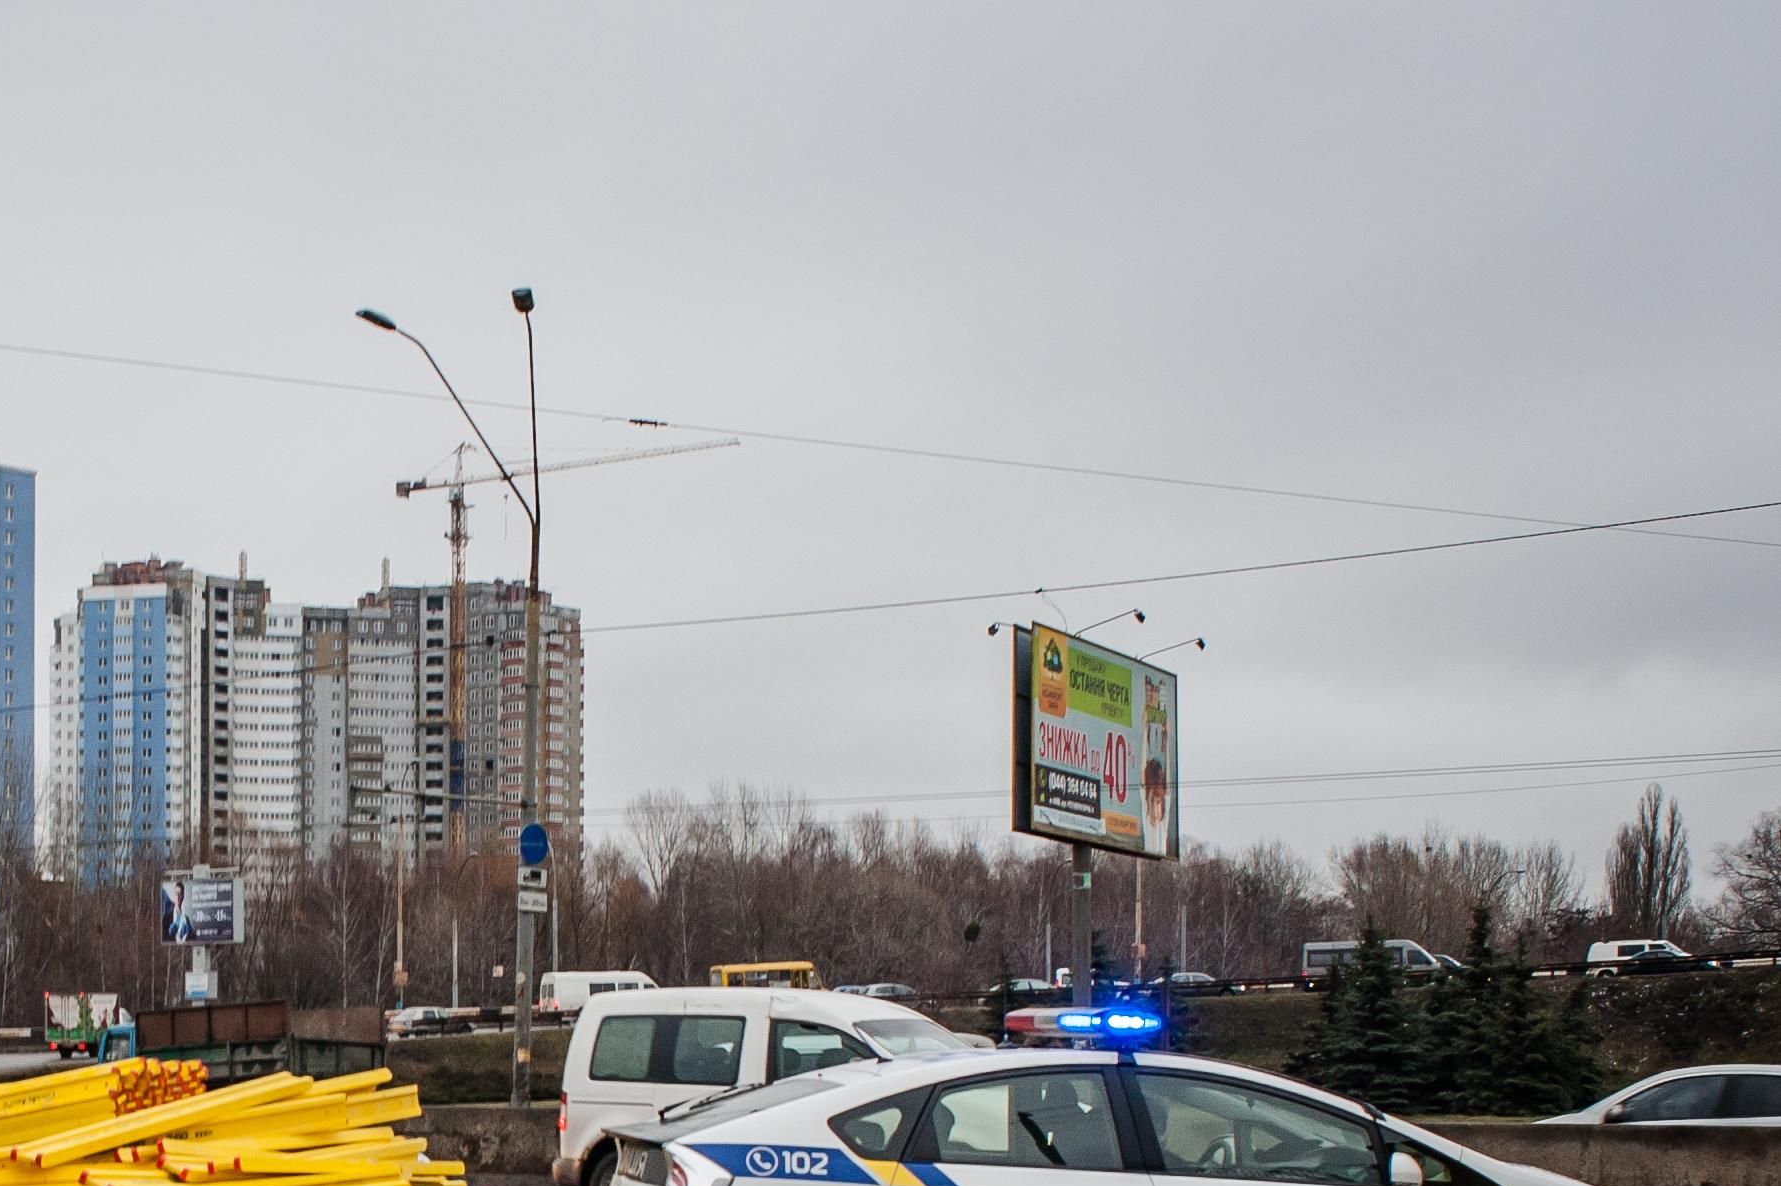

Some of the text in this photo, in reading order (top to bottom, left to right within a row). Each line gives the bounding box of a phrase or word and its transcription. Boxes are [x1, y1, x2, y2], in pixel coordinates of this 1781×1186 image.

[1069, 669, 1130, 706] ОСТАННЯ ЧЕРГА
[1039, 721, 1088, 770] ЗНИЖКА
[782, 1150, 829, 1176] 102
